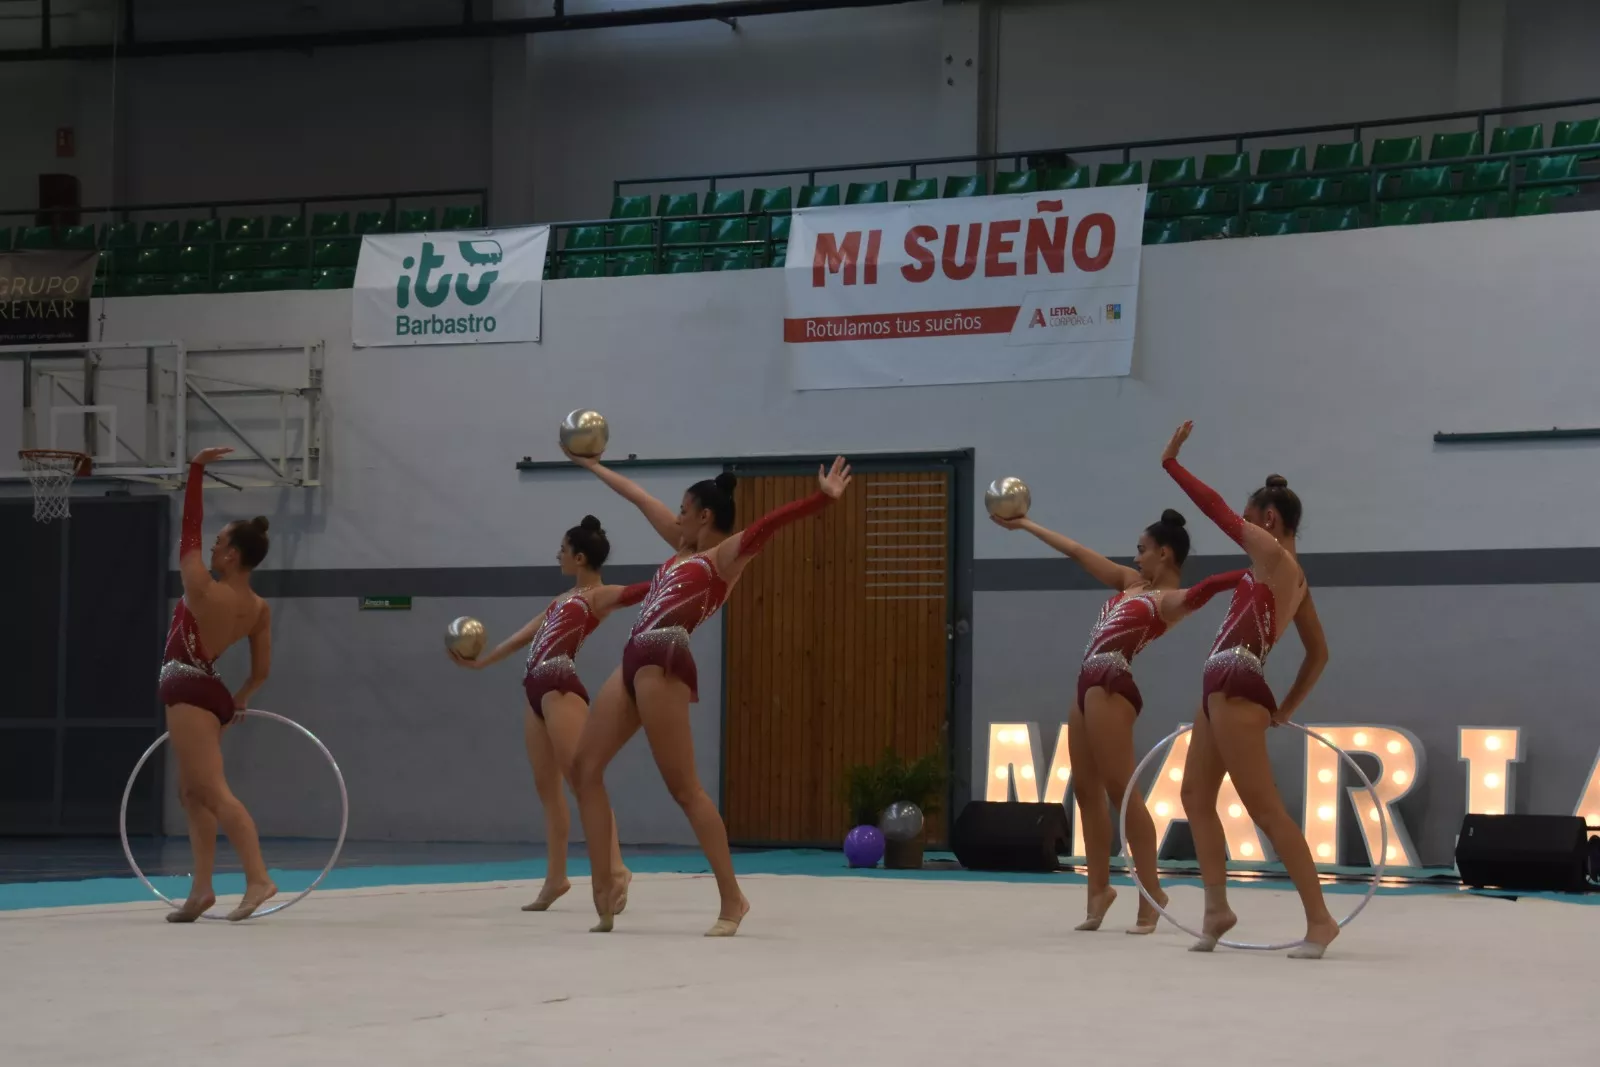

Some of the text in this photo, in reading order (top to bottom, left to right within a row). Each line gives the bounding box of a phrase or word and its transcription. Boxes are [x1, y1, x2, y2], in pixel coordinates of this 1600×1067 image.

[812, 199, 1117, 287] MI SUEÑO
[1049, 306, 1078, 317] LETRA
[396, 313, 497, 336] Barbastro
[806, 313, 982, 338] Rotulamos tus sueños
